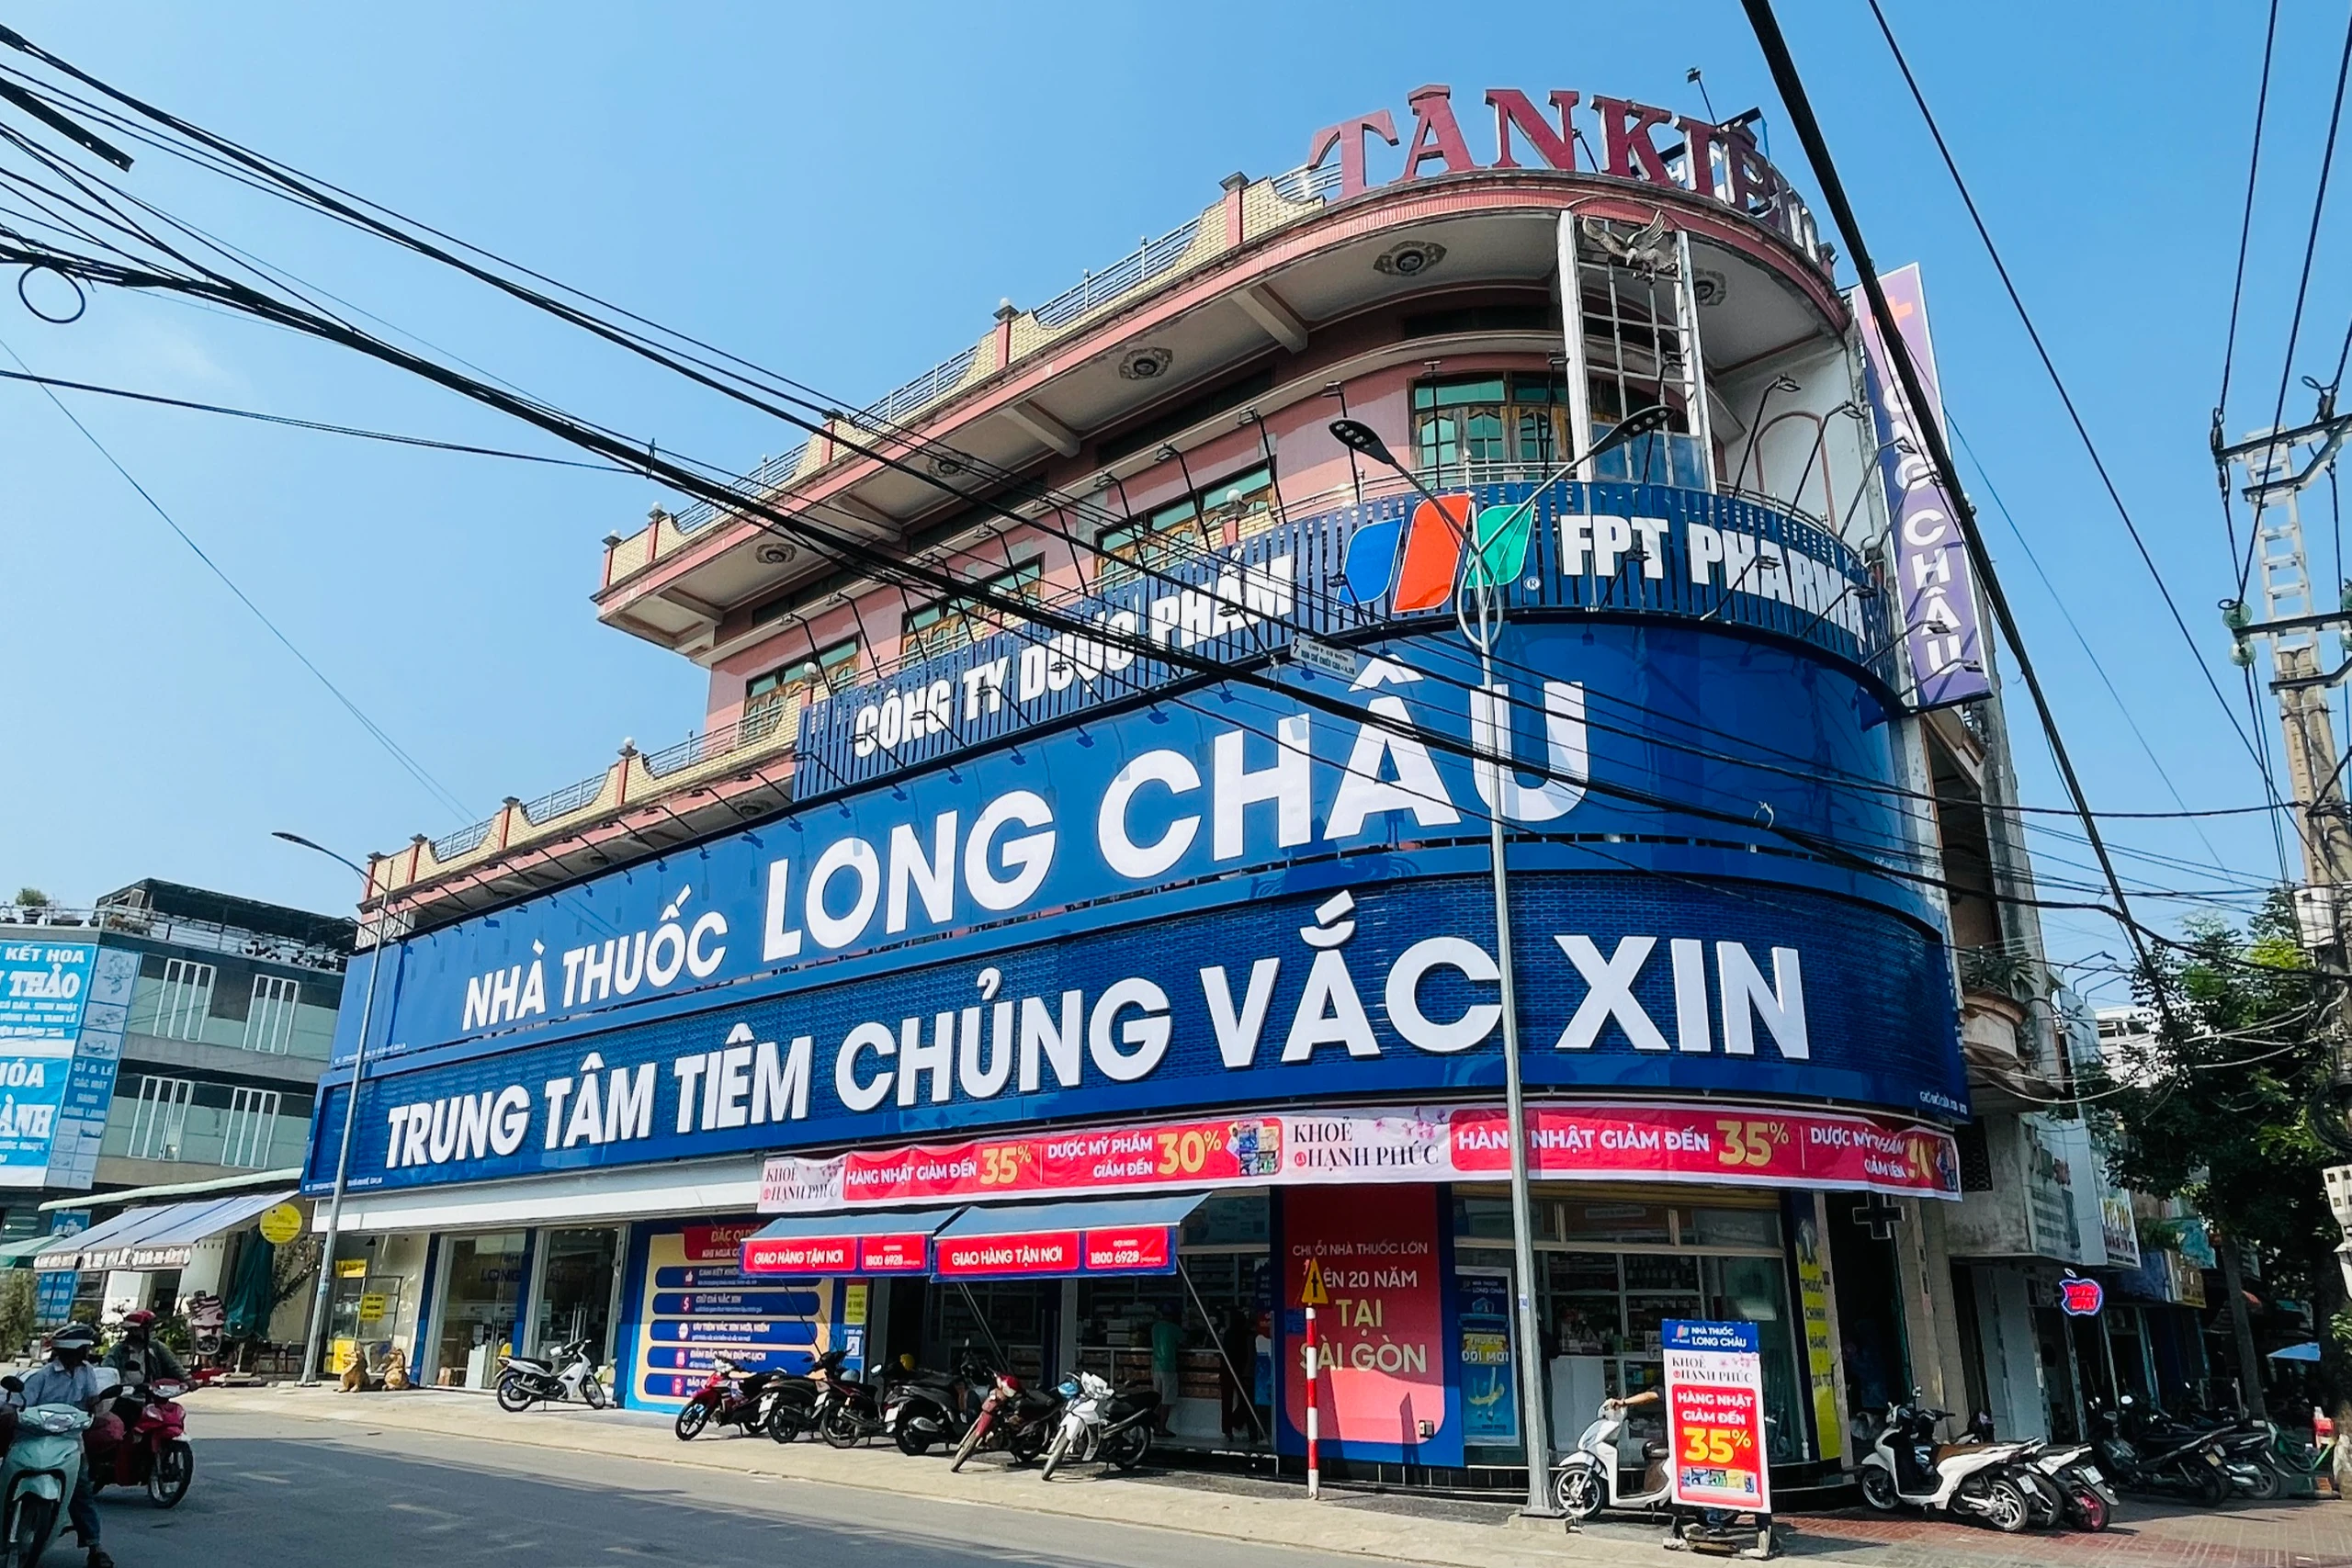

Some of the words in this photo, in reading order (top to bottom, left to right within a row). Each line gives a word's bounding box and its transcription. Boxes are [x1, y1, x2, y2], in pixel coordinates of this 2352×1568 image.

[1559, 514, 1669, 580] FPT
[1688, 522, 1866, 644] PHARMA
[1904, 509, 1962, 675] CHÂU
[854, 678, 950, 758] CÔNG
[963, 656, 1010, 722] TY
[462, 939, 547, 1032] NHÀ
[562, 883, 729, 1006] THUỐC
[763, 790, 1057, 963] LONG
[1098, 653, 1589, 879] CHÂU
[5, 944, 42, 962] KẾT
[46, 949, 85, 963] HOA
[9, 963, 81, 998] THẢO
[386, 1085, 531, 1169] TRUNG
[544, 1052, 658, 1150] TÂM
[674, 1022, 814, 1134] TIÊM
[835, 966, 1172, 1111] CHỦNG
[1200, 889, 1503, 1067] VẮC
[1554, 935, 1811, 1061] XIN
[1048, 1141, 1087, 1162] DƯỢC
[1089, 1136, 1110, 1155] MỸ
[1112, 1131, 1153, 1154] PHẨM
[1458, 1128, 1512, 1150] HÀN
[1532, 1123, 1594, 1154] NHẬT
[1600, 1122, 1659, 1150] GIẢM
[1664, 1125, 1711, 1153] ĐẾN
[1715, 1120, 1790, 1167] 35%
[1810, 1125, 1850, 1149] DƯỢC
[846, 1168, 880, 1185] HÀNG
[880, 1163, 914, 1184] NHẬT
[917, 1158, 947, 1181] GIẢM
[950, 1156, 978, 1178] ĐẾN
[979, 1145, 1032, 1185] 35%
[1092, 1159, 1125, 1179] GIẢM
[1126, 1157, 1153, 1177] ĐẾN
[1157, 1130, 1223, 1178] 30%
[1308, 1146, 1369, 1172] HẠNH
[1377, 1140, 1439, 1167] PHÚC
[754, 1252, 776, 1265] GIAO
[777, 1248, 804, 1265] HÀNG
[806, 1247, 825, 1268] TẬN
[826, 1249, 843, 1263] NƠI
[952, 1251, 979, 1266] GIAO
[980, 1247, 1012, 1265] HÀNG
[1015, 1245, 1039, 1267] TẬN
[1041, 1247, 1062, 1262] NƠI
[1091, 1251, 1114, 1265] 1800
[1114, 1250, 1140, 1264] 6928
[1330, 1242, 1353, 1257] NHÀ
[1357, 1239, 1397, 1256] THUỐC
[1401, 1241, 1428, 1255] LỚN
[1349, 1271, 1370, 1288] 20
[1374, 1267, 1418, 1288] NĂM
[1336, 1299, 1383, 1337] TẠI
[1691, 1325, 1707, 1336] NHÀ
[1708, 1325, 1735, 1336] THUỐC
[1351, 1336, 1427, 1373] GÒN
[1691, 1337, 1719, 1347] LONG
[1720, 1336, 1747, 1348] CHÂU
[1681, 1370, 1716, 1382] HẠNH
[1719, 1370, 1753, 1383] PHÚC
[1678, 1392, 1715, 1406] HÀNG
[1717, 1393, 1753, 1410] NHẬT
[1682, 1408, 1715, 1422] GIẢM
[1718, 1409, 1746, 1425] ĐẾN
[1682, 1427, 1752, 1464] 35%
